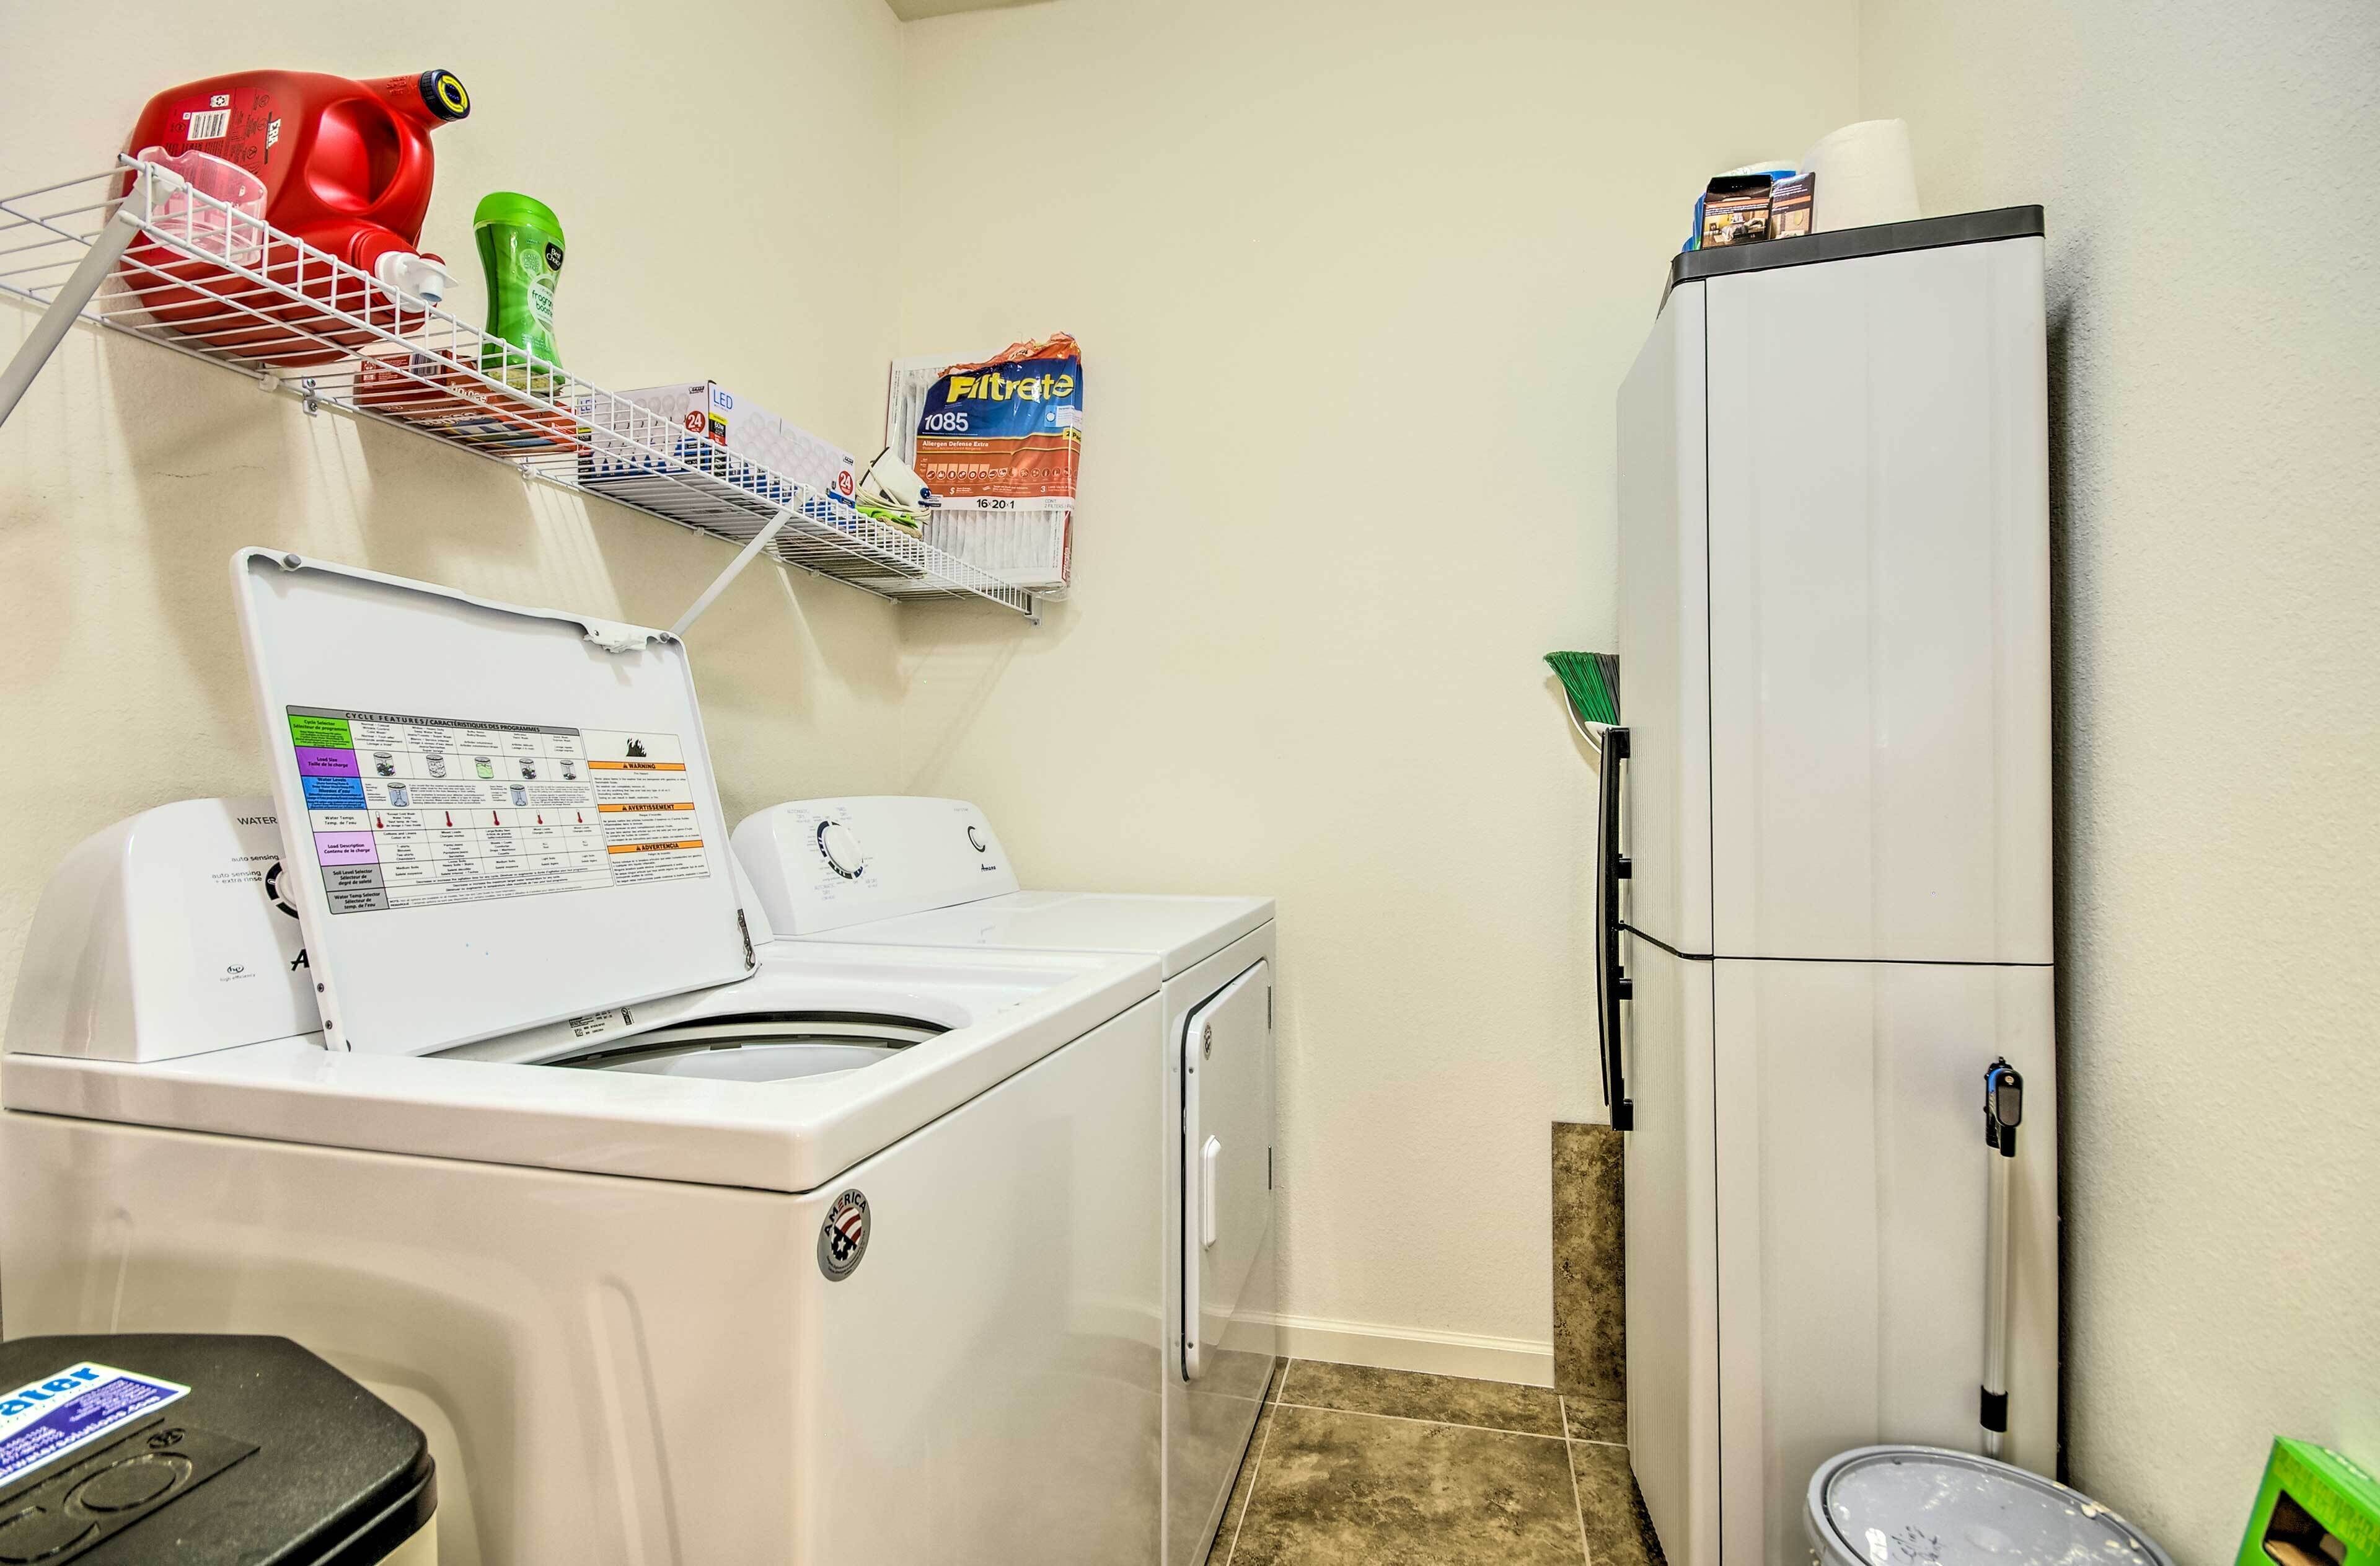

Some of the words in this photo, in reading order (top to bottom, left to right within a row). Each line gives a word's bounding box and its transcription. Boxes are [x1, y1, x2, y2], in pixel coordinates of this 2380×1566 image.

[266, 119, 281, 149] ERA
[946, 373, 1074, 403] Filtrete
[714, 389, 733, 409] LED
[688, 414, 702, 428] 24
[925, 412, 969, 431] 1085
[840, 473, 851, 490] 24
[346, 712, 374, 720] CYCLE
[379, 715, 423, 725] FEATURES
[430, 719, 487, 729] CARACTÉRISTIQUES
[237, 816, 278, 825] WATER
[642, 843, 679, 851] ADVERTENCIA
[824, 1192, 866, 1237] AMERICA
